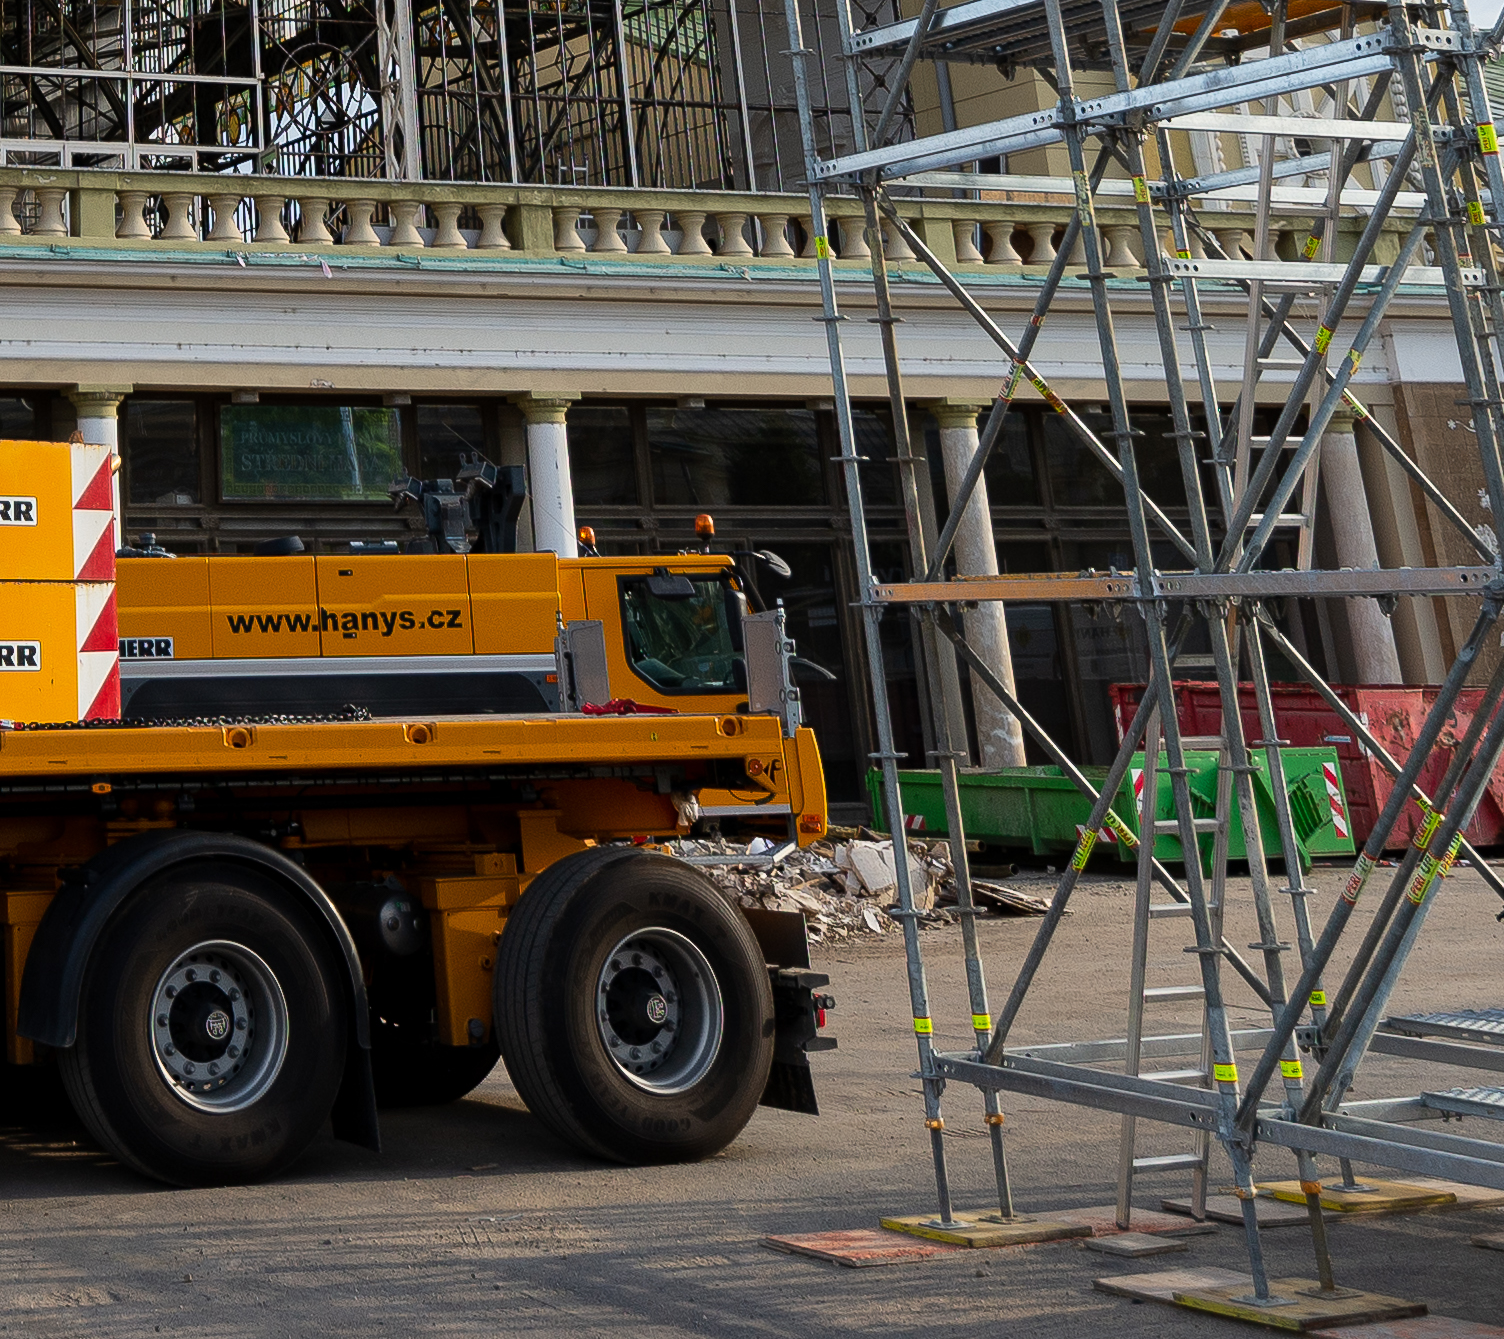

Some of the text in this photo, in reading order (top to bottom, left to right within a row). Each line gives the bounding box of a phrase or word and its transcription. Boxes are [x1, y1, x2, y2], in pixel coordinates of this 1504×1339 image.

[227, 607, 463, 636] www.hanys.cz
[1412, 855, 1431, 895] PERI UP
[1442, 851, 1454, 871] PERI
[1348, 874, 1361, 896] PERI
[648, 890, 705, 919] KMAX
